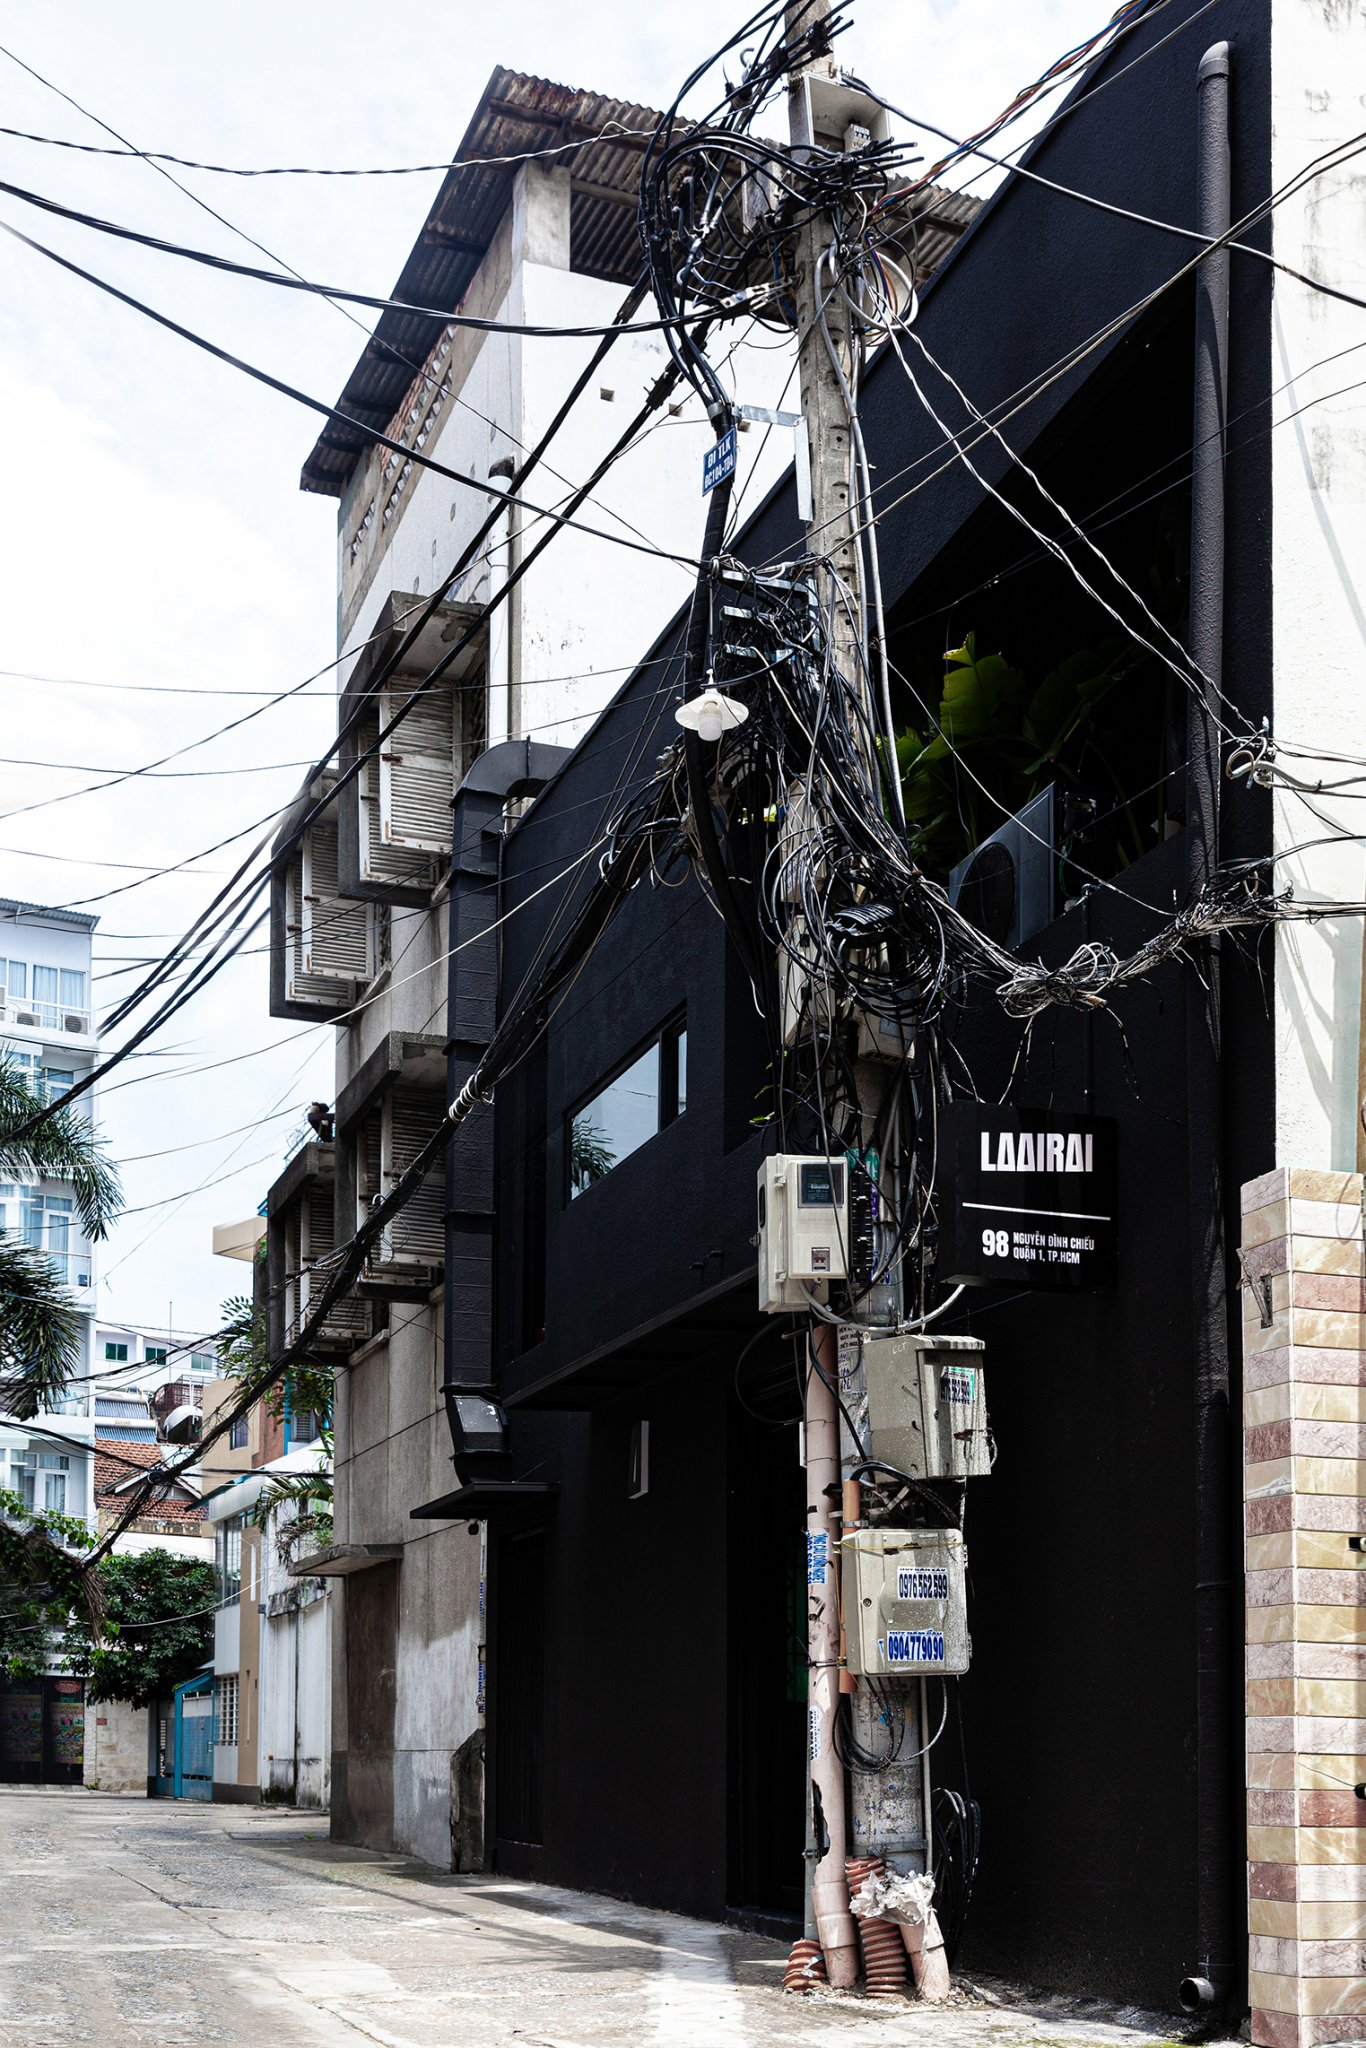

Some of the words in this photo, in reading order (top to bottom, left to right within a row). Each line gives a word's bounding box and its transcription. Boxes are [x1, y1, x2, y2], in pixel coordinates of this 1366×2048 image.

[981, 1132, 1093, 1172] LAAIRAI
[982, 1229, 1009, 1257] 98
[1038, 1249, 1046, 1262] 1,
[1047, 1250, 1080, 1264] TP.HCM
